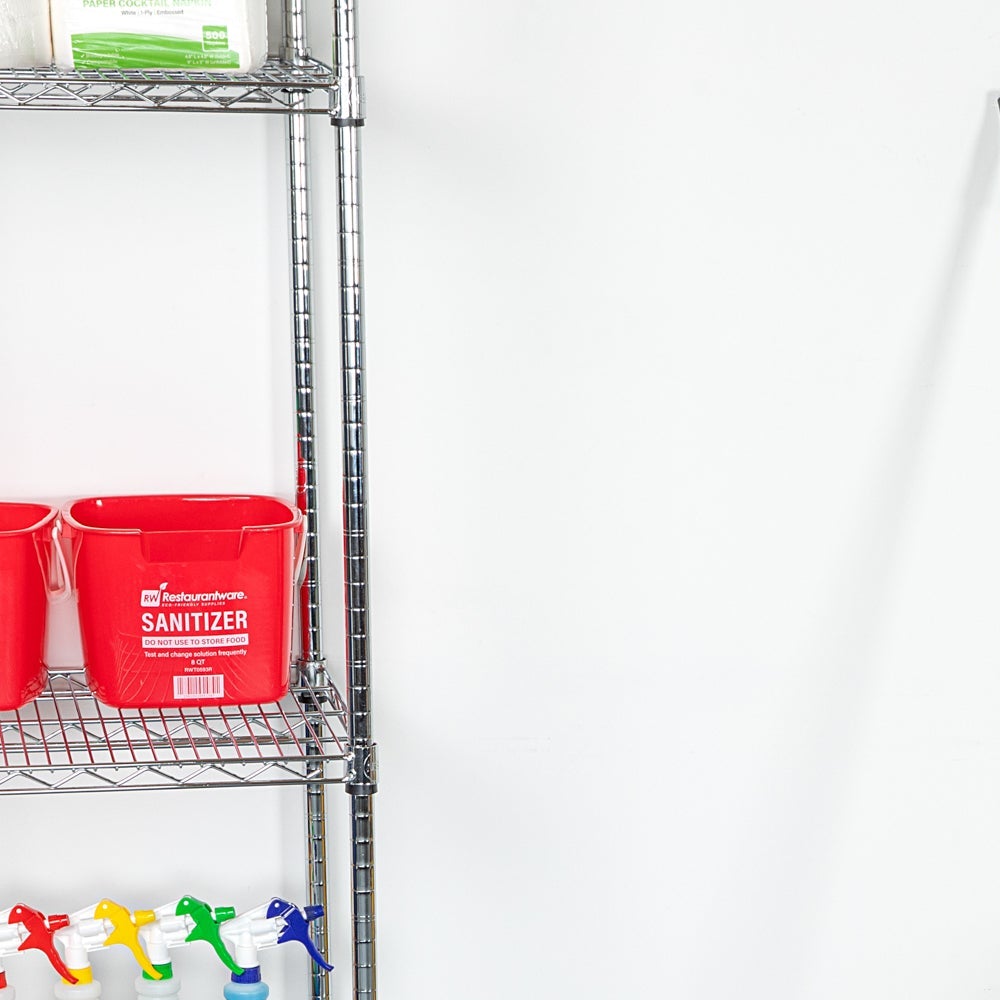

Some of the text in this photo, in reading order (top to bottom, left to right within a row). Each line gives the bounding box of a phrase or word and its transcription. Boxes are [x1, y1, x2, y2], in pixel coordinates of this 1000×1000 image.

[205, 31, 226, 40] 500
[141, 610, 248, 632] SANITIZER
[226, 636, 246, 644] FOOD
[170, 651, 193, 659] change
[218, 649, 247, 657] frequently
